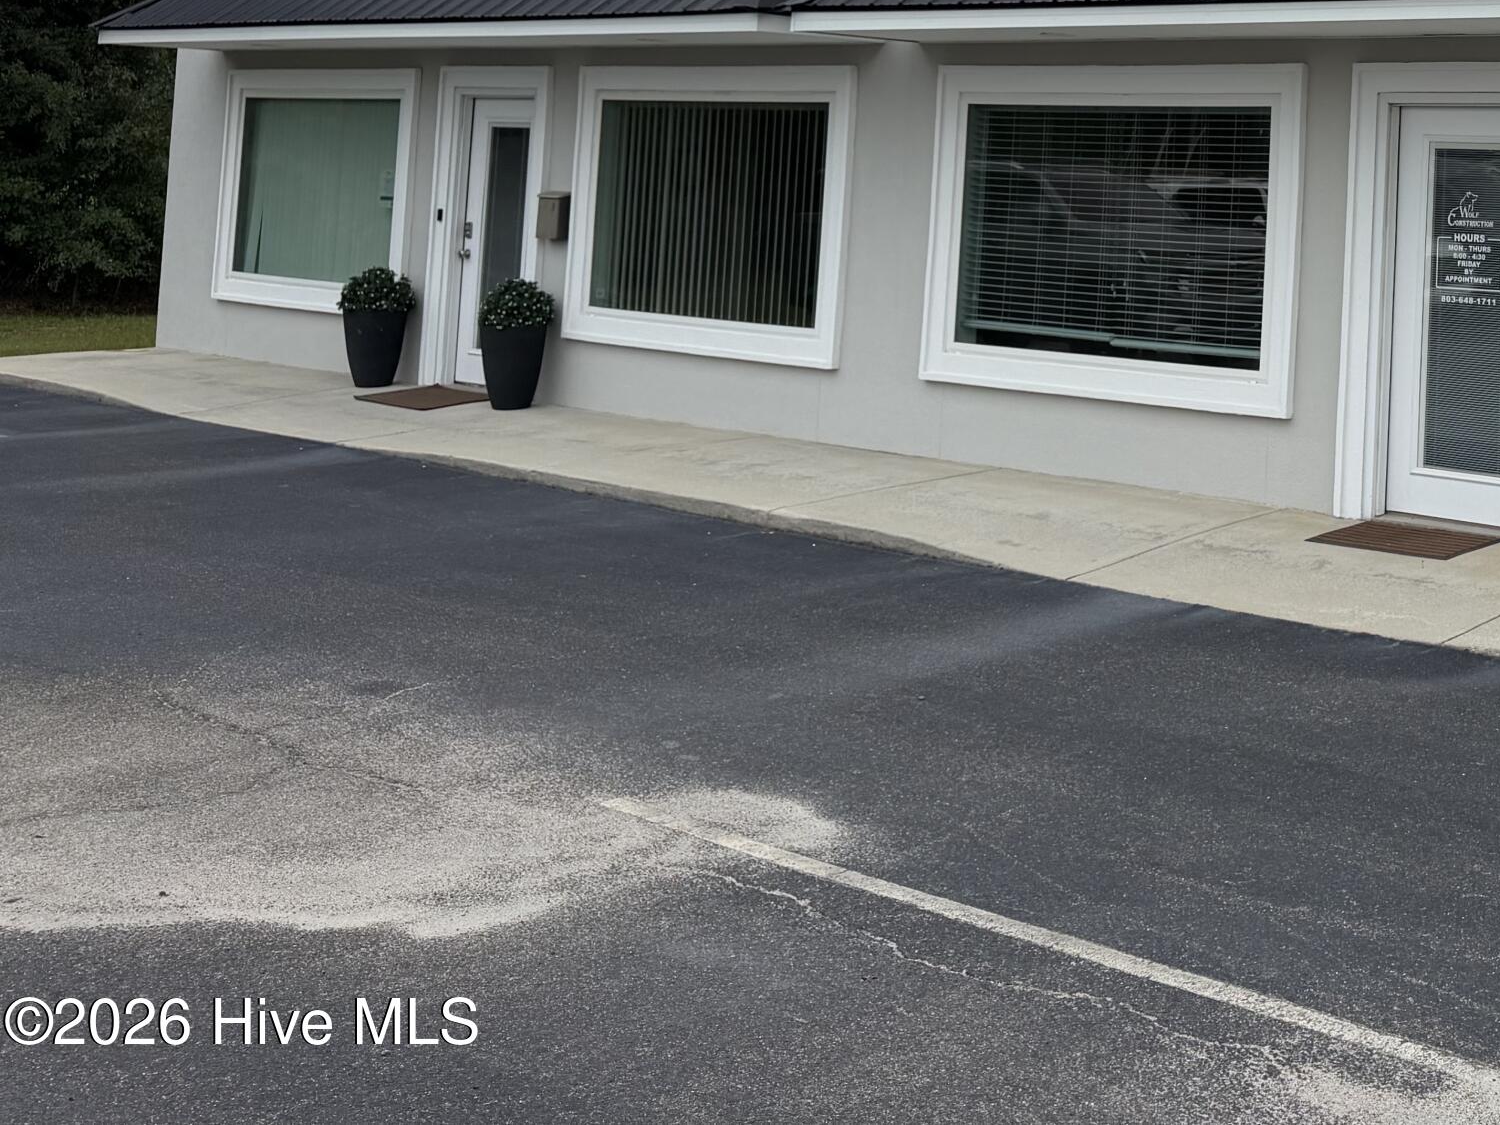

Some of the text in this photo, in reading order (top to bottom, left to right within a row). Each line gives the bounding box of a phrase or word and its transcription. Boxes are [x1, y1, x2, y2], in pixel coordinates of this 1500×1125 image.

[1453, 233, 1486, 243] HOURS
[1448, 244, 1464, 252] MON
[1468, 245, 1492, 254] THURS
[1457, 260, 1481, 268] FRIDAY
[1444, 275, 1493, 284] APPOINTMENT
[1441, 295, 1497, 306] 803-648-1711
